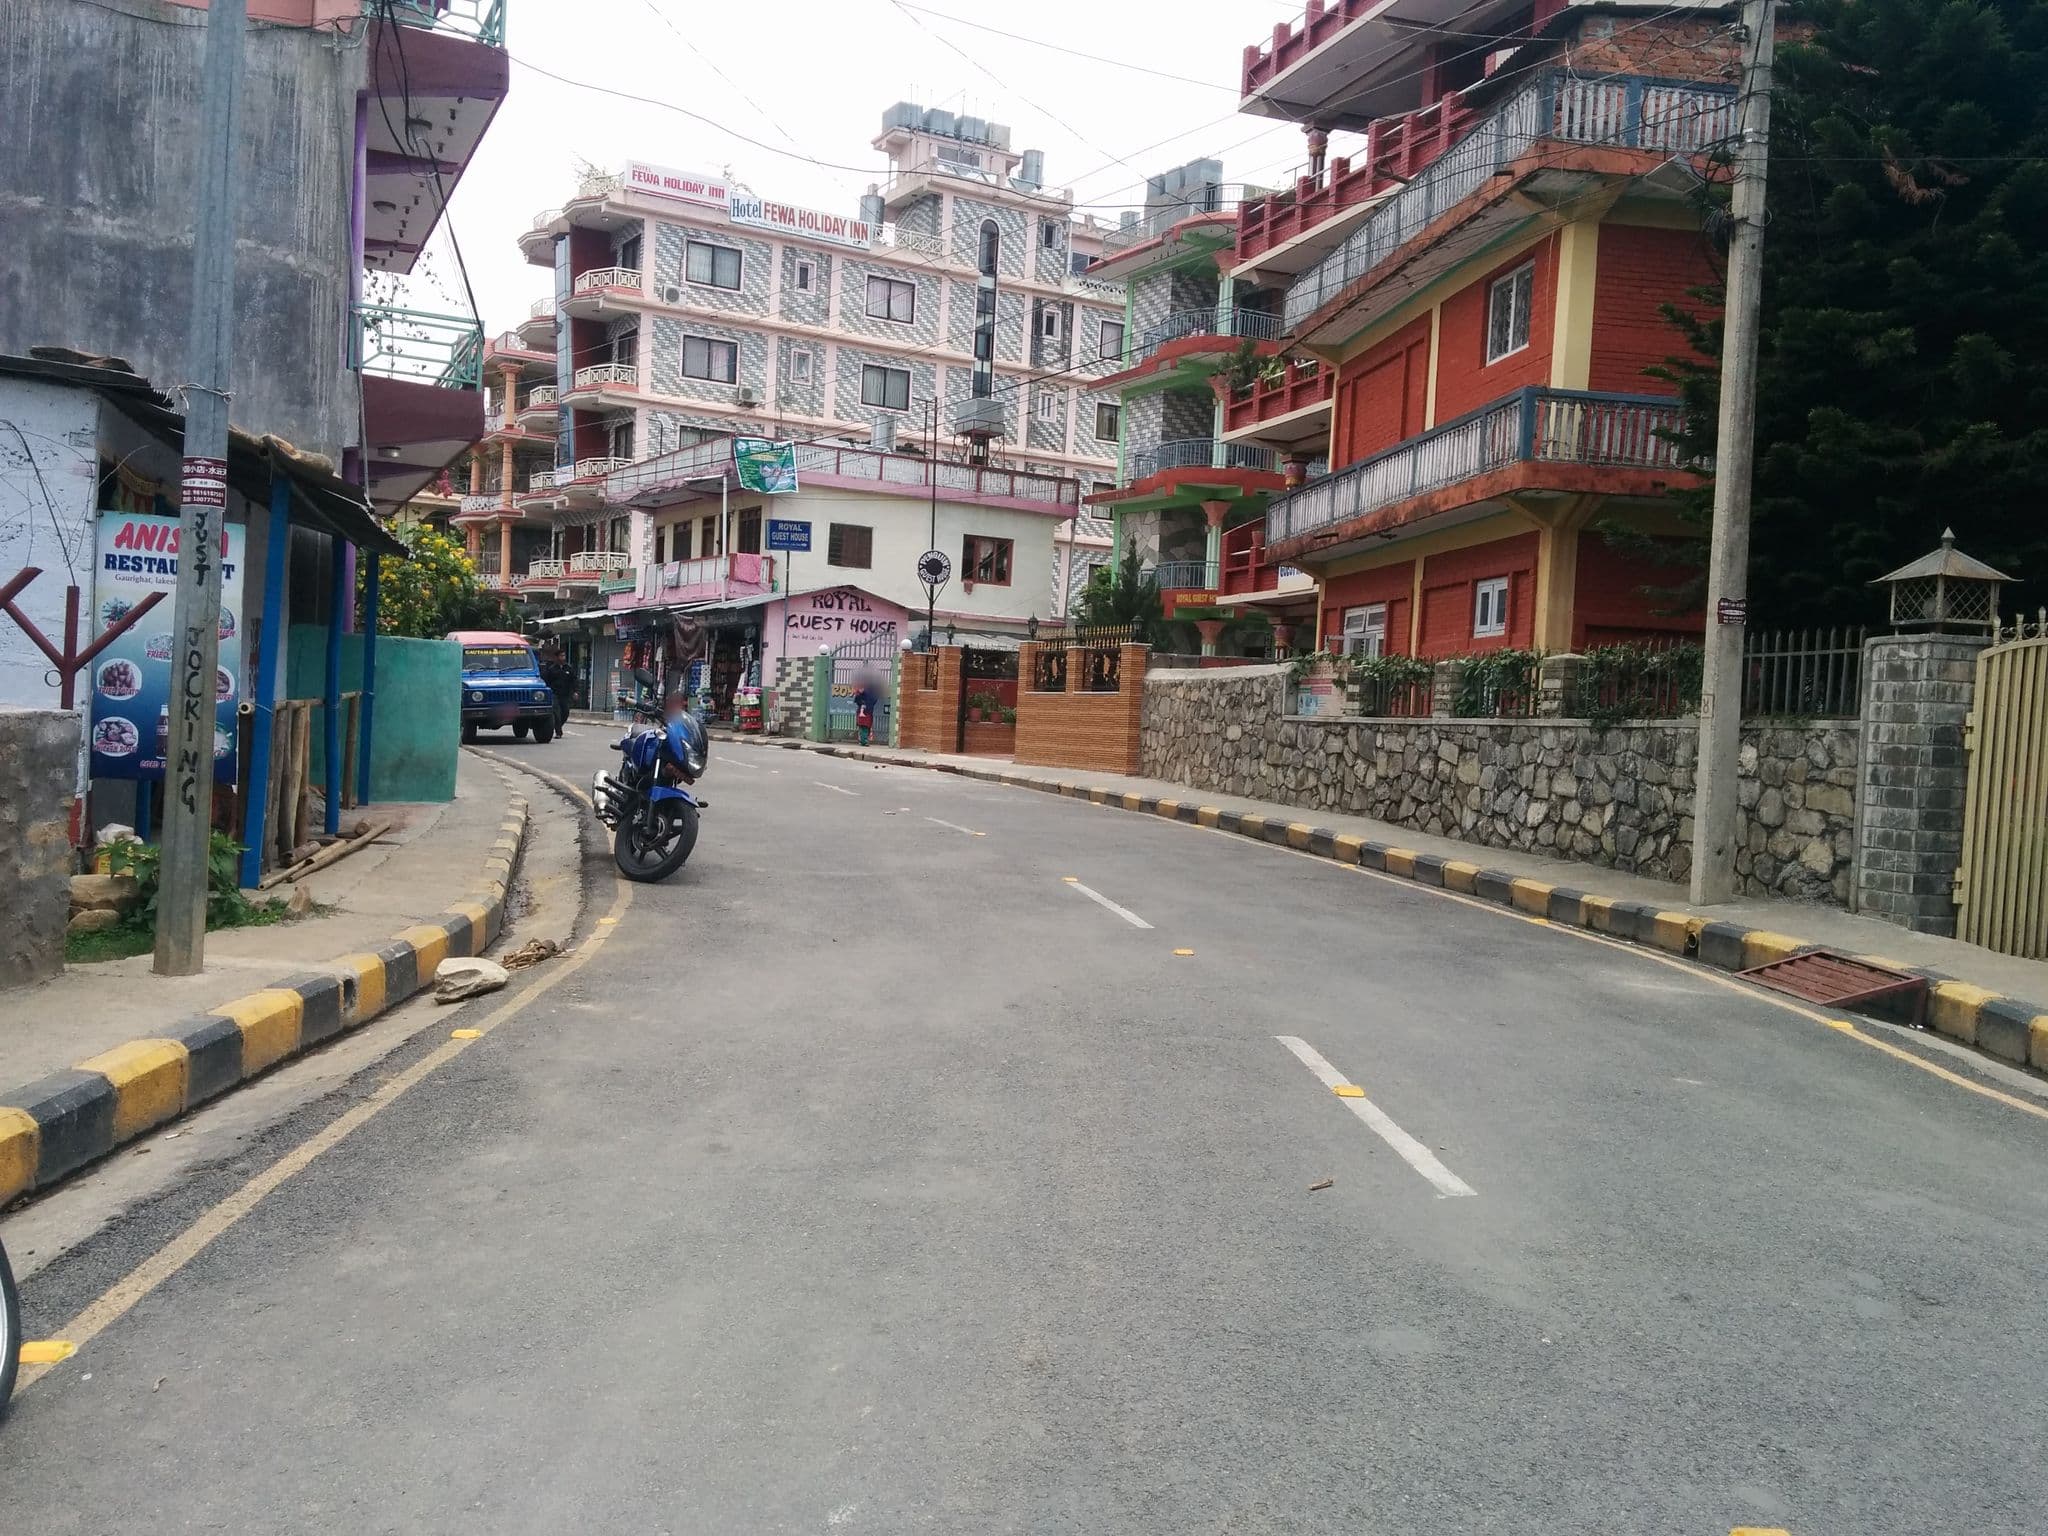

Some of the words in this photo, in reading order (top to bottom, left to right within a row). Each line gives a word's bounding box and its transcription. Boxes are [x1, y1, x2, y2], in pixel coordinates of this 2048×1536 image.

[632, 170, 660, 186] FEWA
[663, 177, 705, 195] HOLIDAY
[708, 185, 725, 199] INN
[732, 198, 762, 218] Hotel
[763, 201, 796, 227] FEWA
[798, 209, 848, 237] HOLIDAY
[849, 220, 869, 241] INN
[771, 531, 789, 541] GUEST
[790, 533, 808, 542] HOUSE
[778, 522, 803, 532] ROYAL
[193, 511, 211, 587] JUST
[920, 551, 950, 567] PENGUIN
[115, 573, 153, 585] Gaurighat,
[919, 568, 936, 583] GUEST
[936, 567, 950, 583] HOUSE
[811, 590, 872, 612] ROYAL
[787, 614, 845, 633] GUEST
[850, 618, 897, 634] HOUSE
[177, 626, 206, 815] JOCKING
